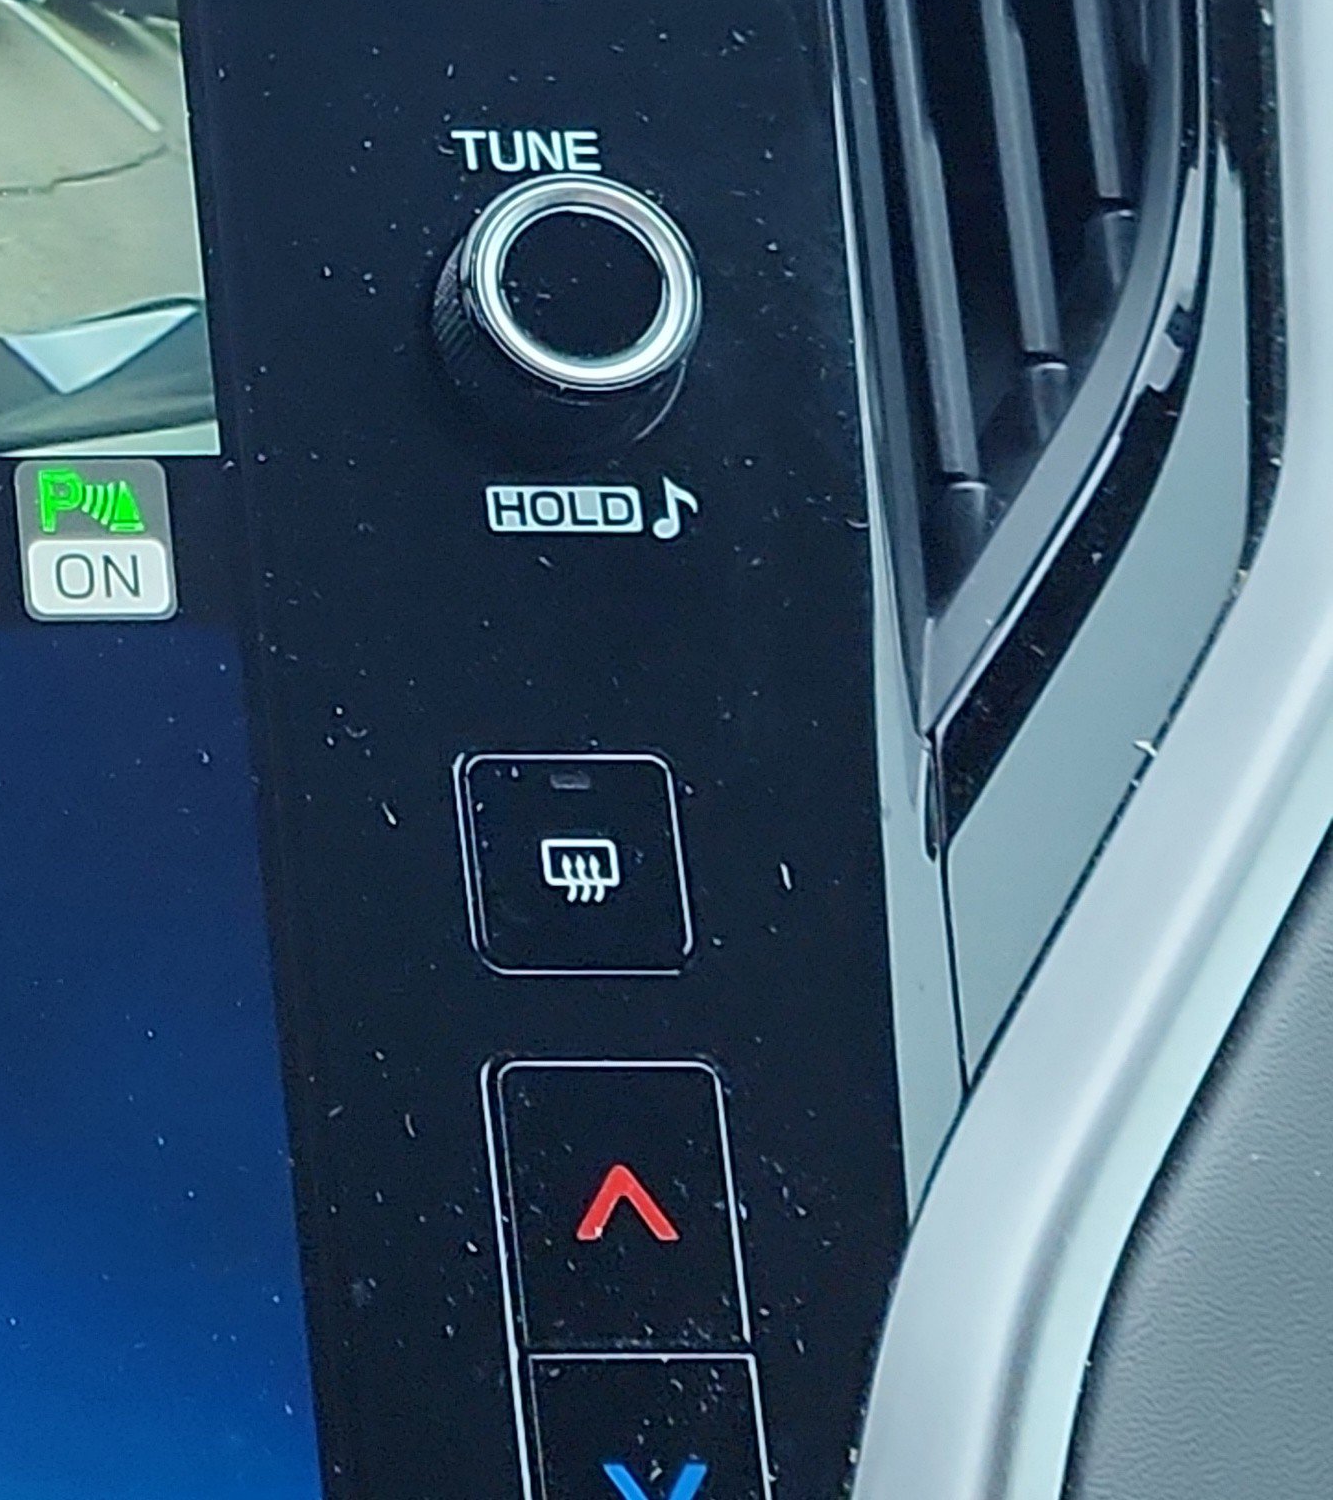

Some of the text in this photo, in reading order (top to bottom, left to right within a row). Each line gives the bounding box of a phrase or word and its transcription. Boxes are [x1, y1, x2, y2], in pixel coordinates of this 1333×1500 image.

[451, 131, 601, 171] TUNE
[494, 492, 633, 527] HOLD
[55, 554, 139, 599] ON
